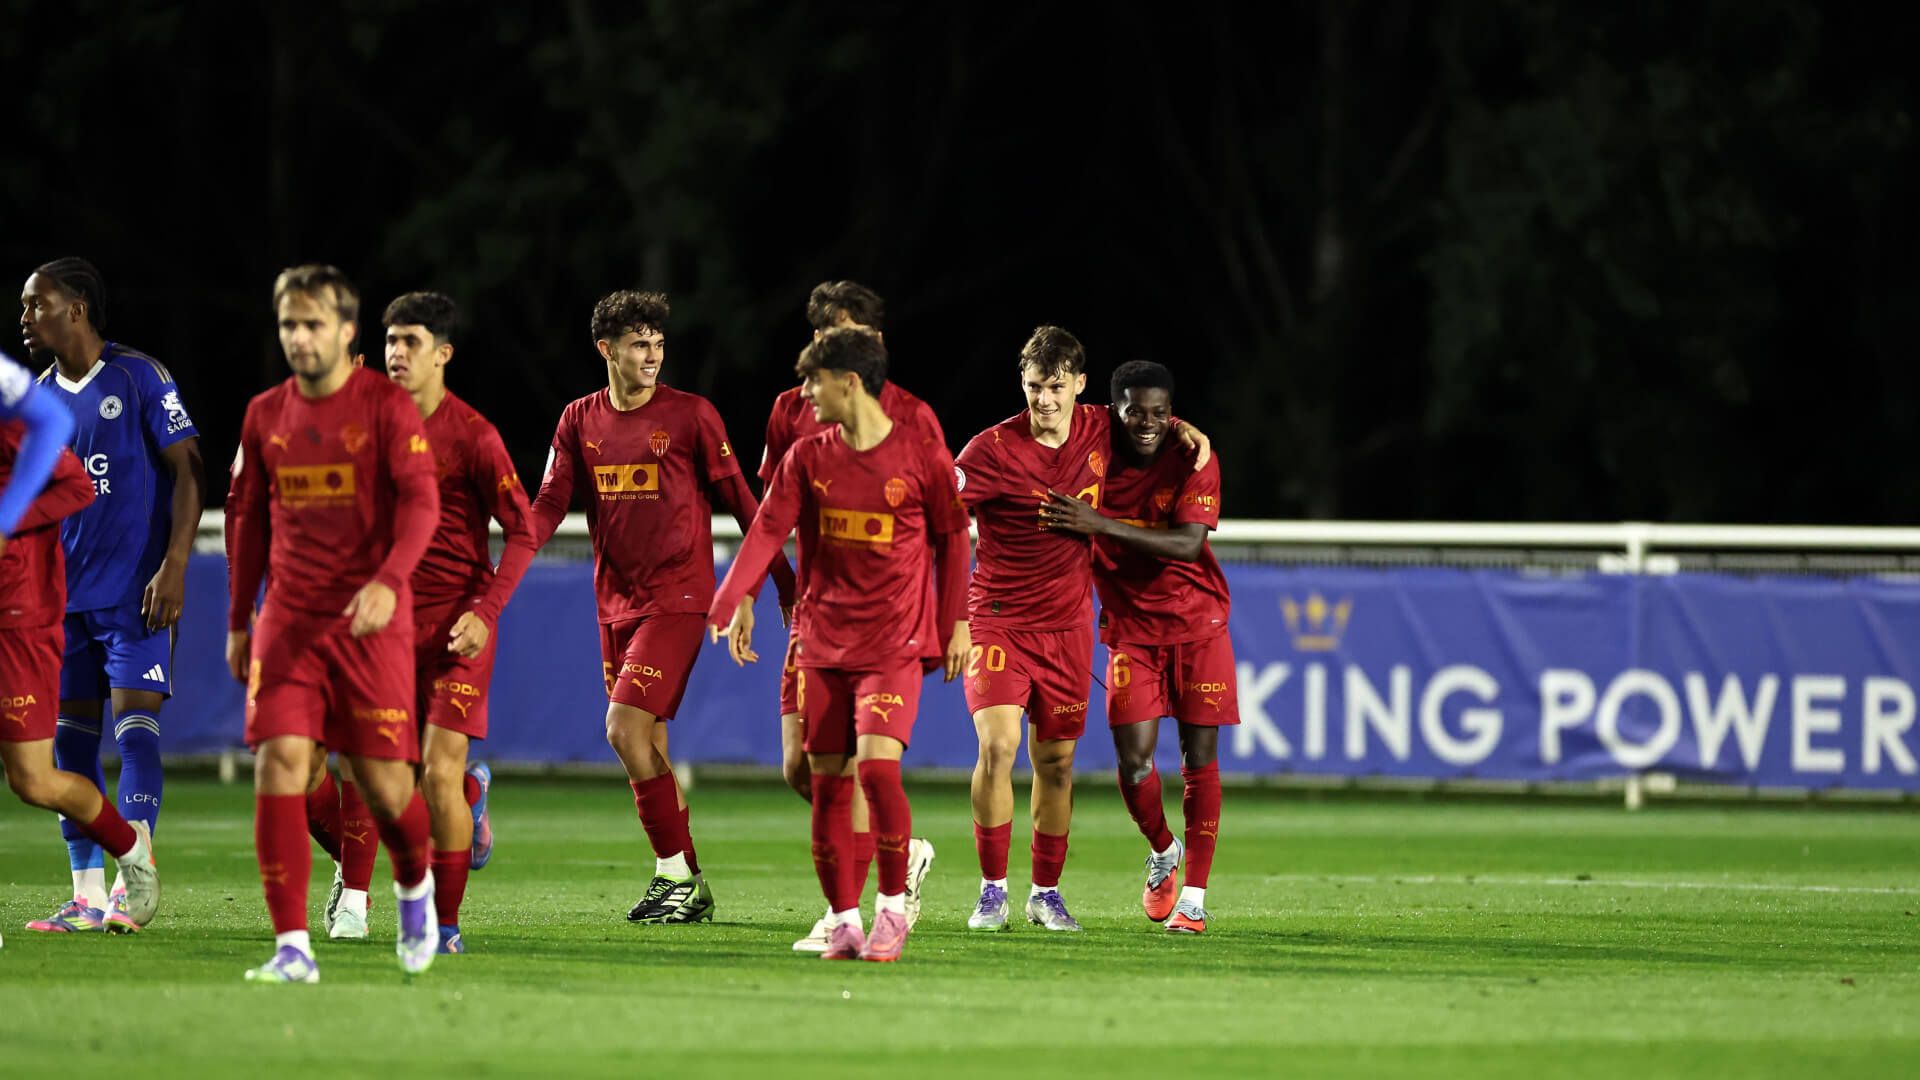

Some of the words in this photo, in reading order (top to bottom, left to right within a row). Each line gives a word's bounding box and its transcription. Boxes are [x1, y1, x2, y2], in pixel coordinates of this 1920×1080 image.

[598, 472, 618, 487] TM
[638, 493, 660, 501] Group
[824, 516, 849, 532] TM
[967, 645, 1006, 678] 20
[1113, 653, 1131, 688] 6
[1234, 661, 1503, 766] KING
[1539, 667, 1918, 773] POWER
